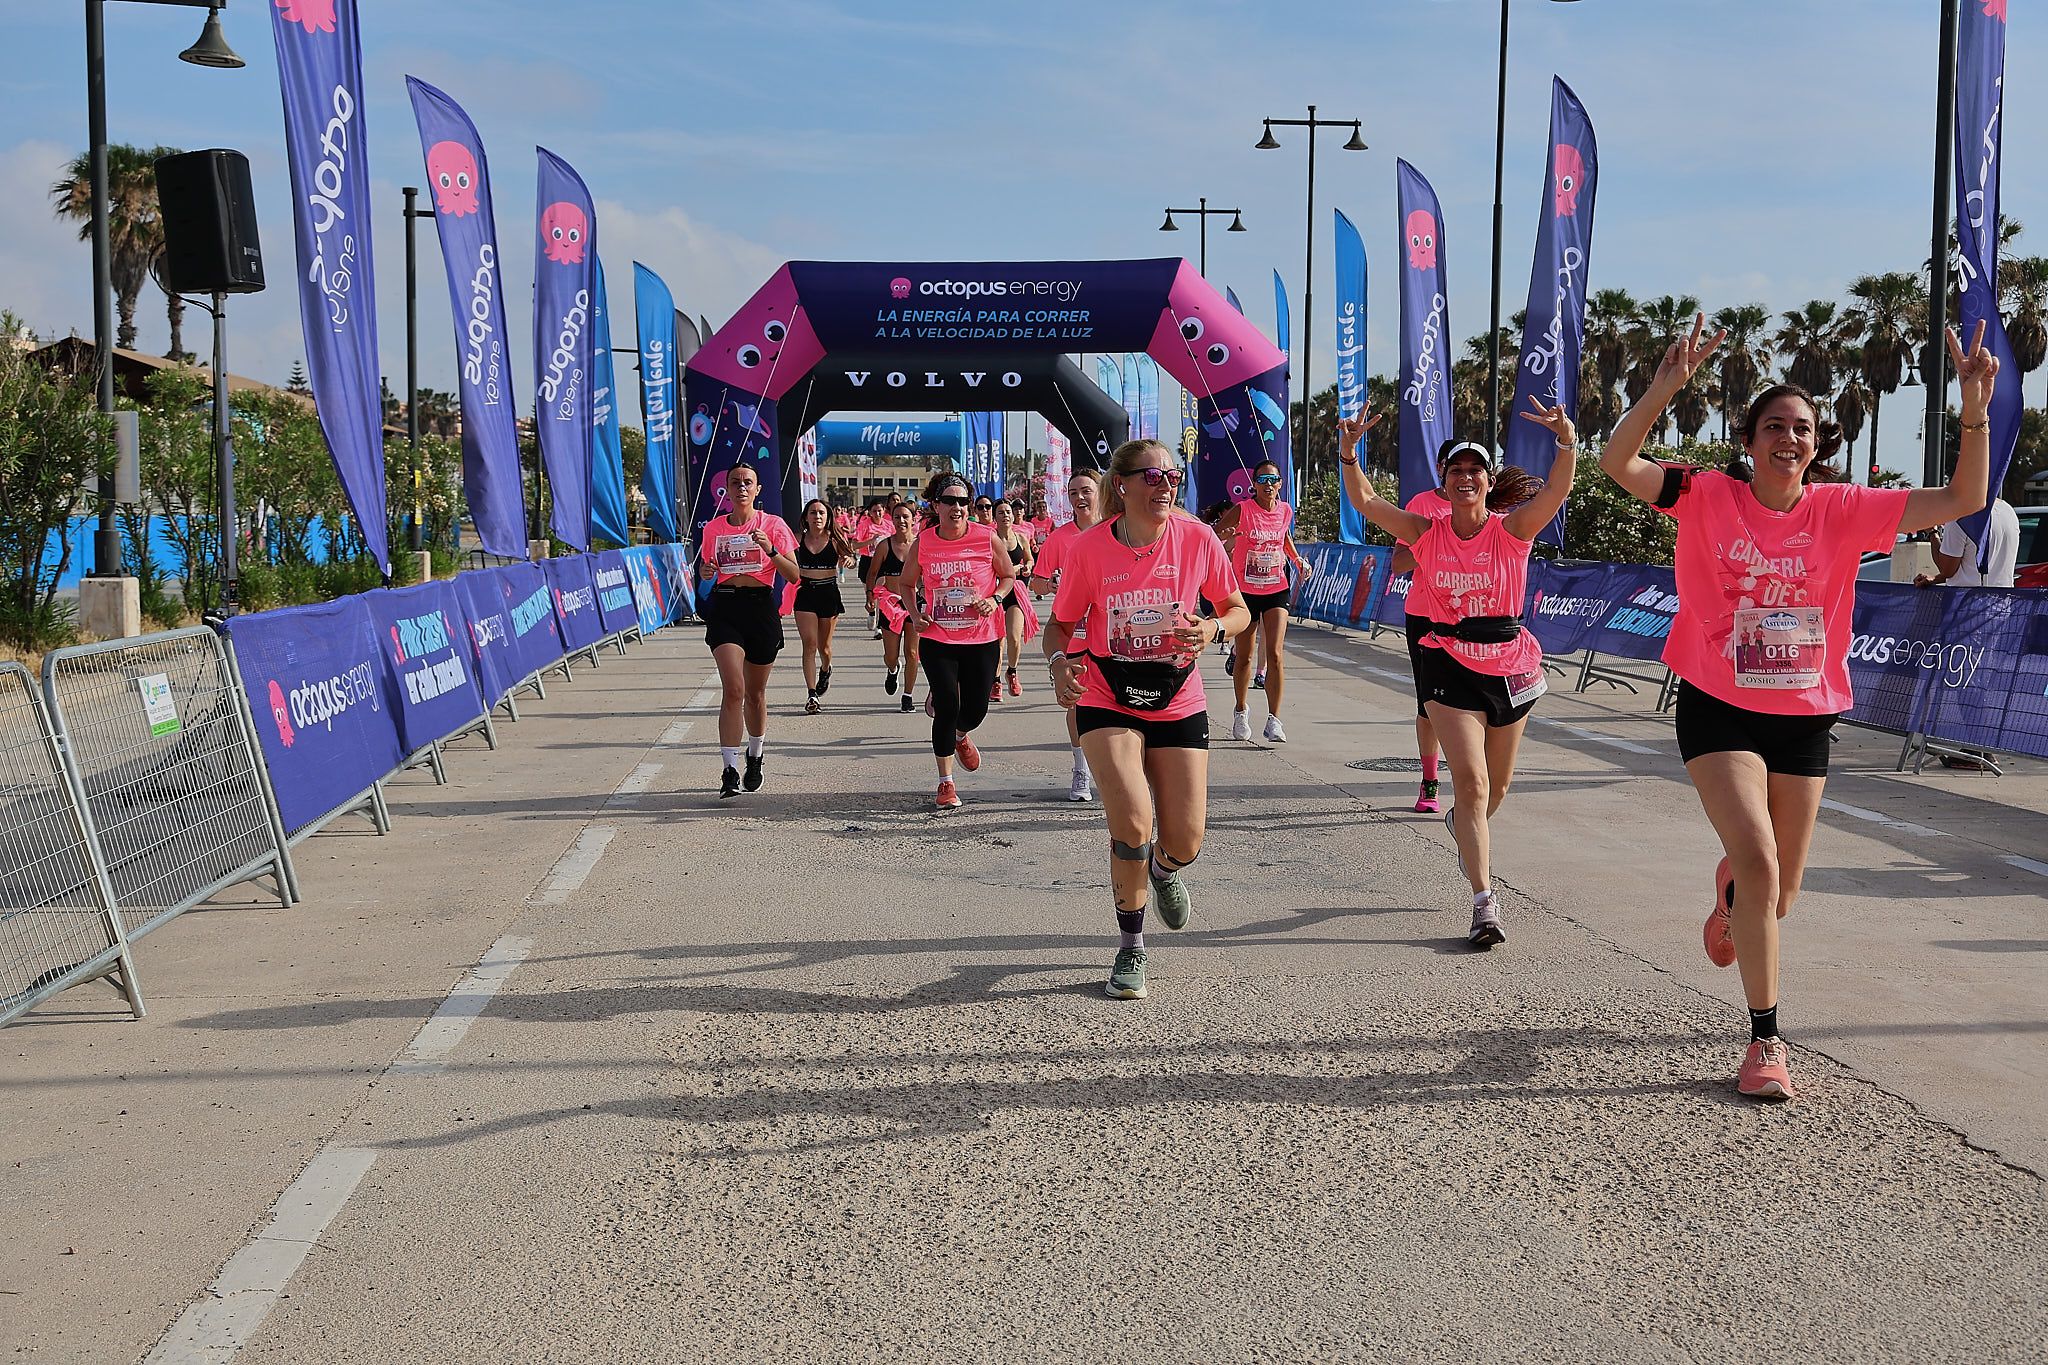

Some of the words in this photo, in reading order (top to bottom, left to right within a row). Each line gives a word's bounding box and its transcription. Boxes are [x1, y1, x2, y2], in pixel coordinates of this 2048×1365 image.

[919, 280, 1006, 300] octopus
[1010, 281, 1082, 302] energy
[877, 310, 898, 322] LA
[902, 307, 972, 323] ENERGÍA
[977, 310, 1020, 323] PARA
[1025, 310, 1090, 322] CORRER
[875, 328, 887, 338] A
[891, 328, 911, 338] LA
[917, 328, 1008, 338] VELOCIDAD
[1012, 328, 1033, 338] DE
[1037, 328, 1057, 338] LA
[1062, 328, 1093, 338] LUZ
[845, 372, 1022, 387] VOLVO
[861, 425, 921, 450] Marlene
[730, 550, 747, 558] 016
[930, 560, 972, 575] CARRERA
[1435, 570, 1492, 591] CARRERA
[1106, 587, 1174, 610] CARRERA
[947, 605, 965, 613] 016
[1539, 593, 1577, 620] octopus
[1764, 619, 1798, 627] ASTURIANA
[1133, 635, 1162, 650] 016
[1766, 644, 1800, 659] 016
[1893, 638, 1984, 689] energy
[1745, 676, 1776, 684] OYSHO
[290, 672, 347, 732] octopus
[342, 660, 380, 713] energy
[1125, 686, 1161, 697] Reebok
